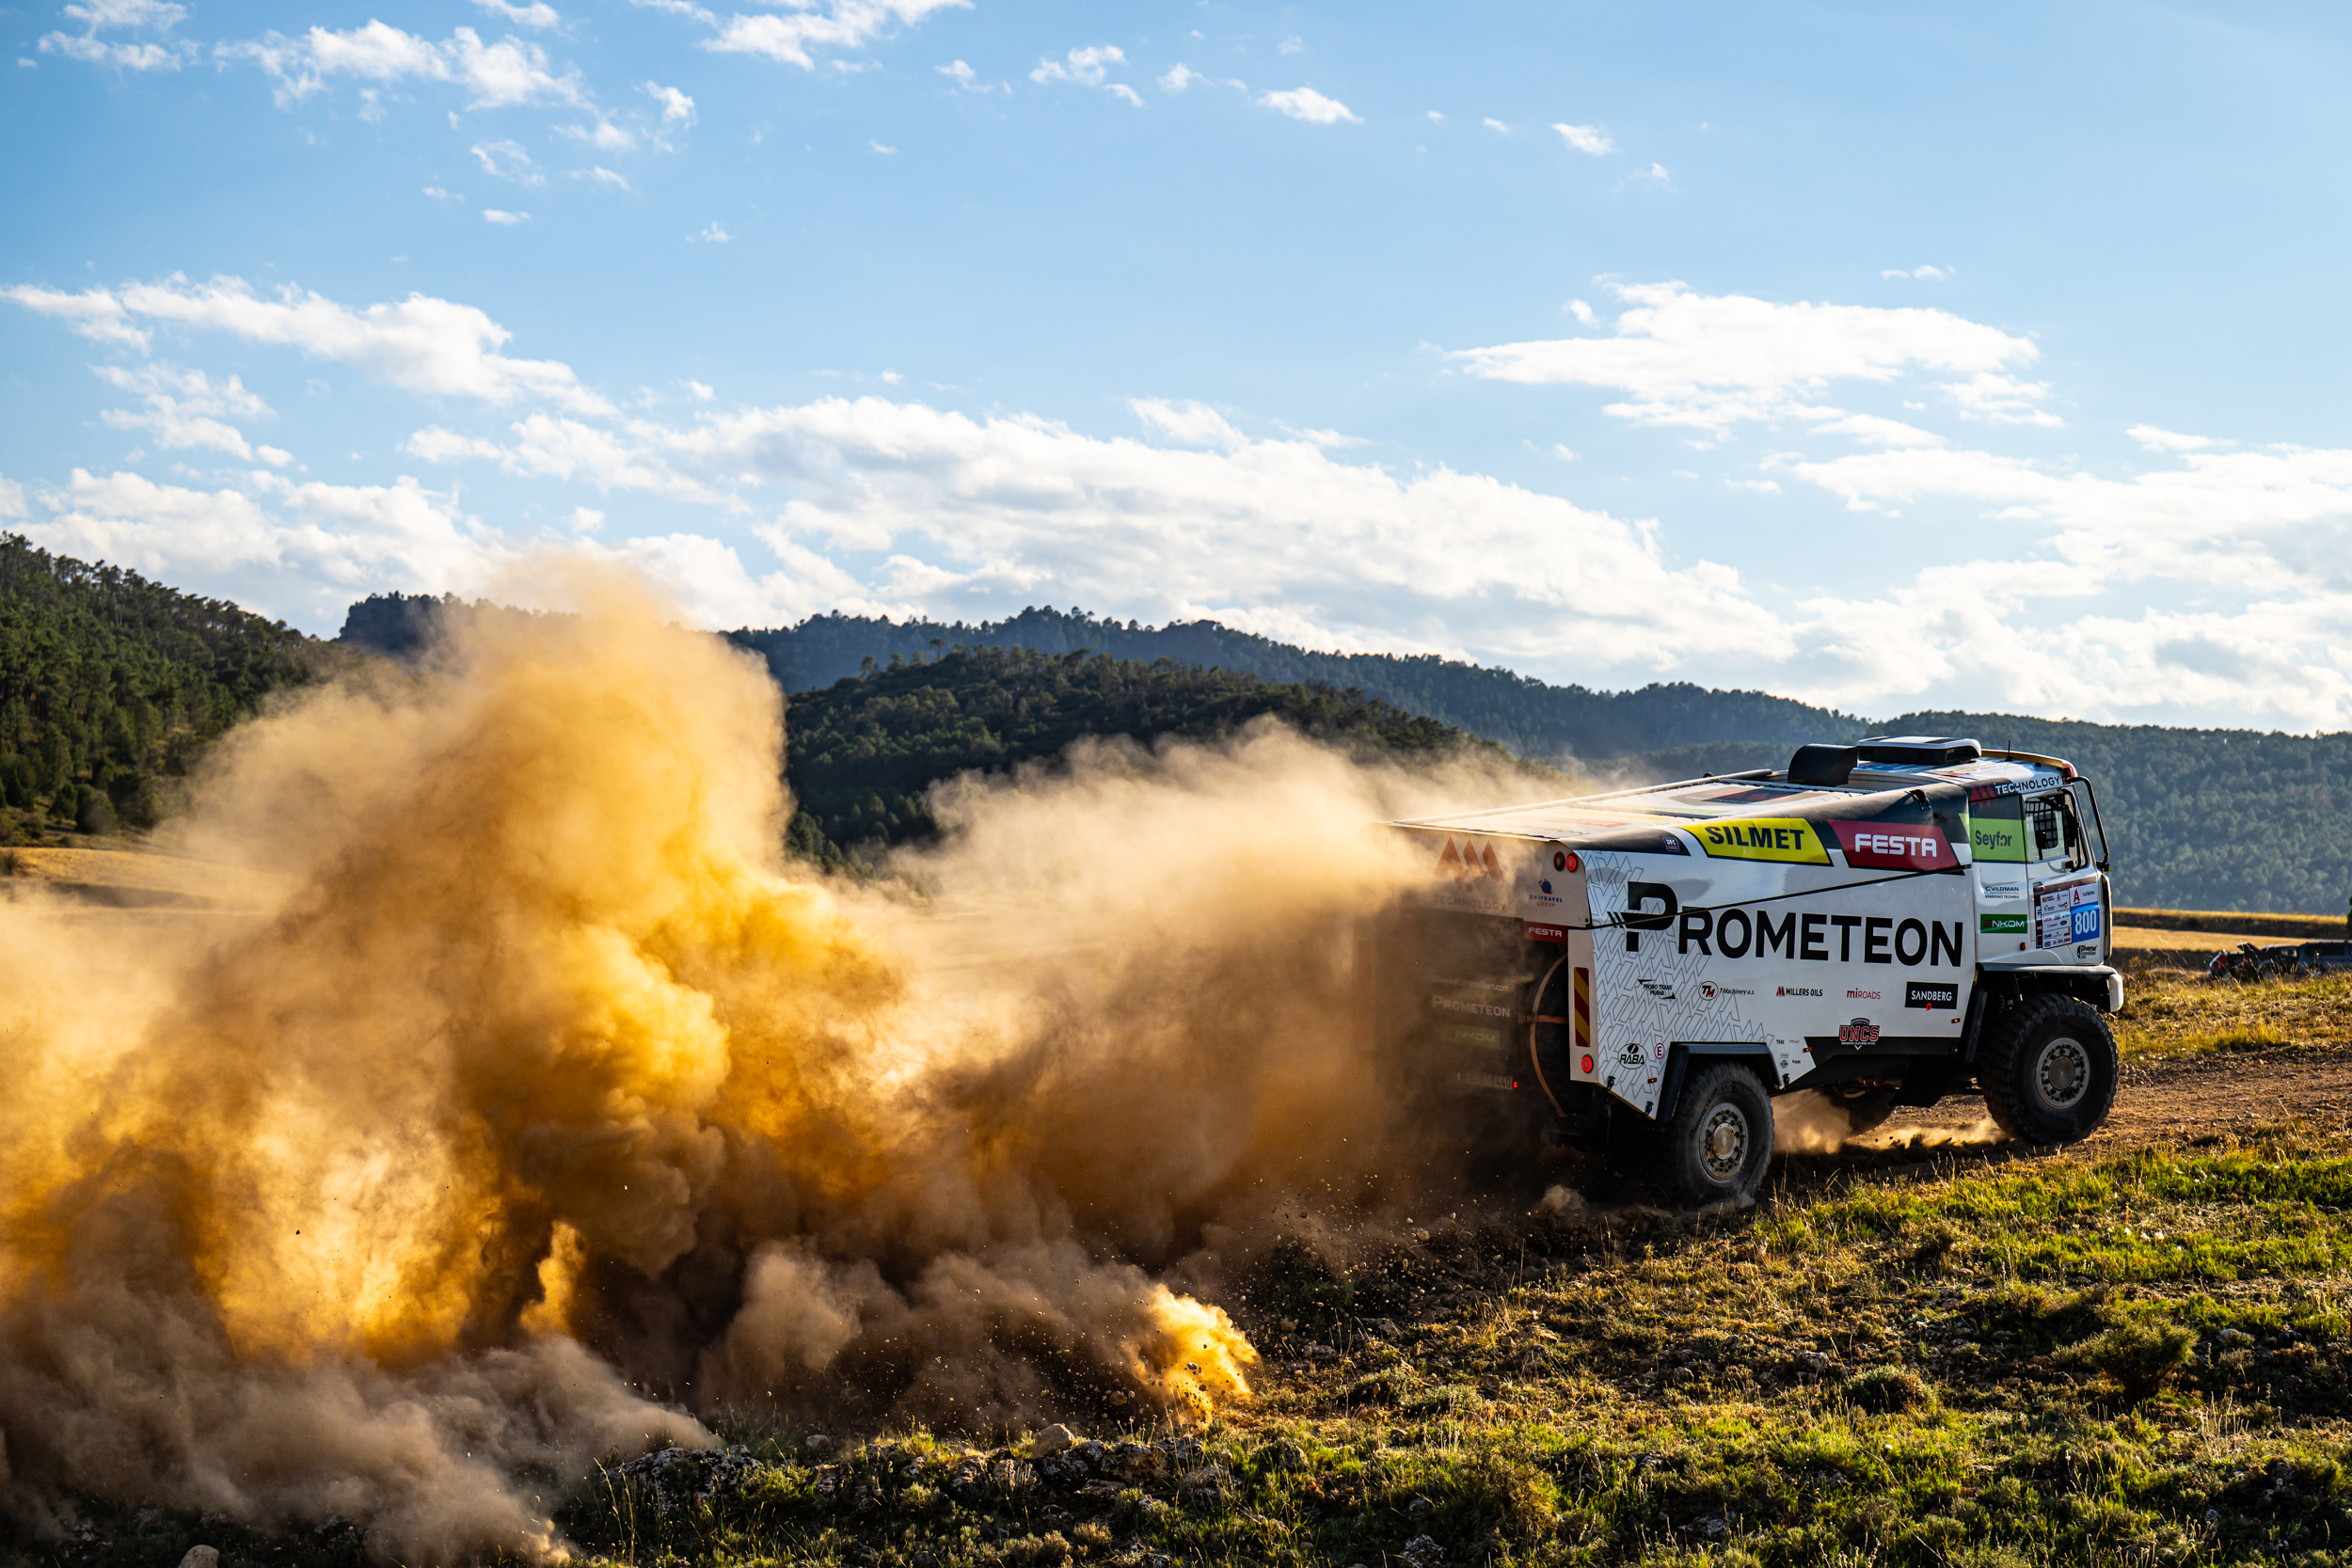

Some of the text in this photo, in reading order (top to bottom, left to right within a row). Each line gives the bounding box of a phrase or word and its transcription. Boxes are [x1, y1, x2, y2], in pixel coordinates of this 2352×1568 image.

[1995, 776, 2060, 795] TECHNOLOGY
[1705, 825, 1804, 850] SILMET
[1854, 833, 1937, 857] FESTA
[1433, 895, 1506, 911] TECHNOLOGY
[1529, 895, 1563, 903] UNITRAVEL
[1618, 881, 1963, 968] PROMETEON
[1984, 919, 2025, 927] ENKOM
[2074, 910, 2097, 935] 800
[1528, 927, 1563, 938] FESTA
[1786, 988, 1809, 997] MILLERS
[1810, 989, 1823, 997] OILS
[1846, 988, 1881, 1000] miROADS
[1911, 990, 1953, 1002] SANDBERG
[1430, 994, 1511, 1019] PROMETEON
[1445, 1029, 1497, 1043] NKOM
[1839, 1025, 1880, 1042] UNCS
[1657, 1046, 1662, 1056] E
[1619, 1053, 1645, 1064] RABA
